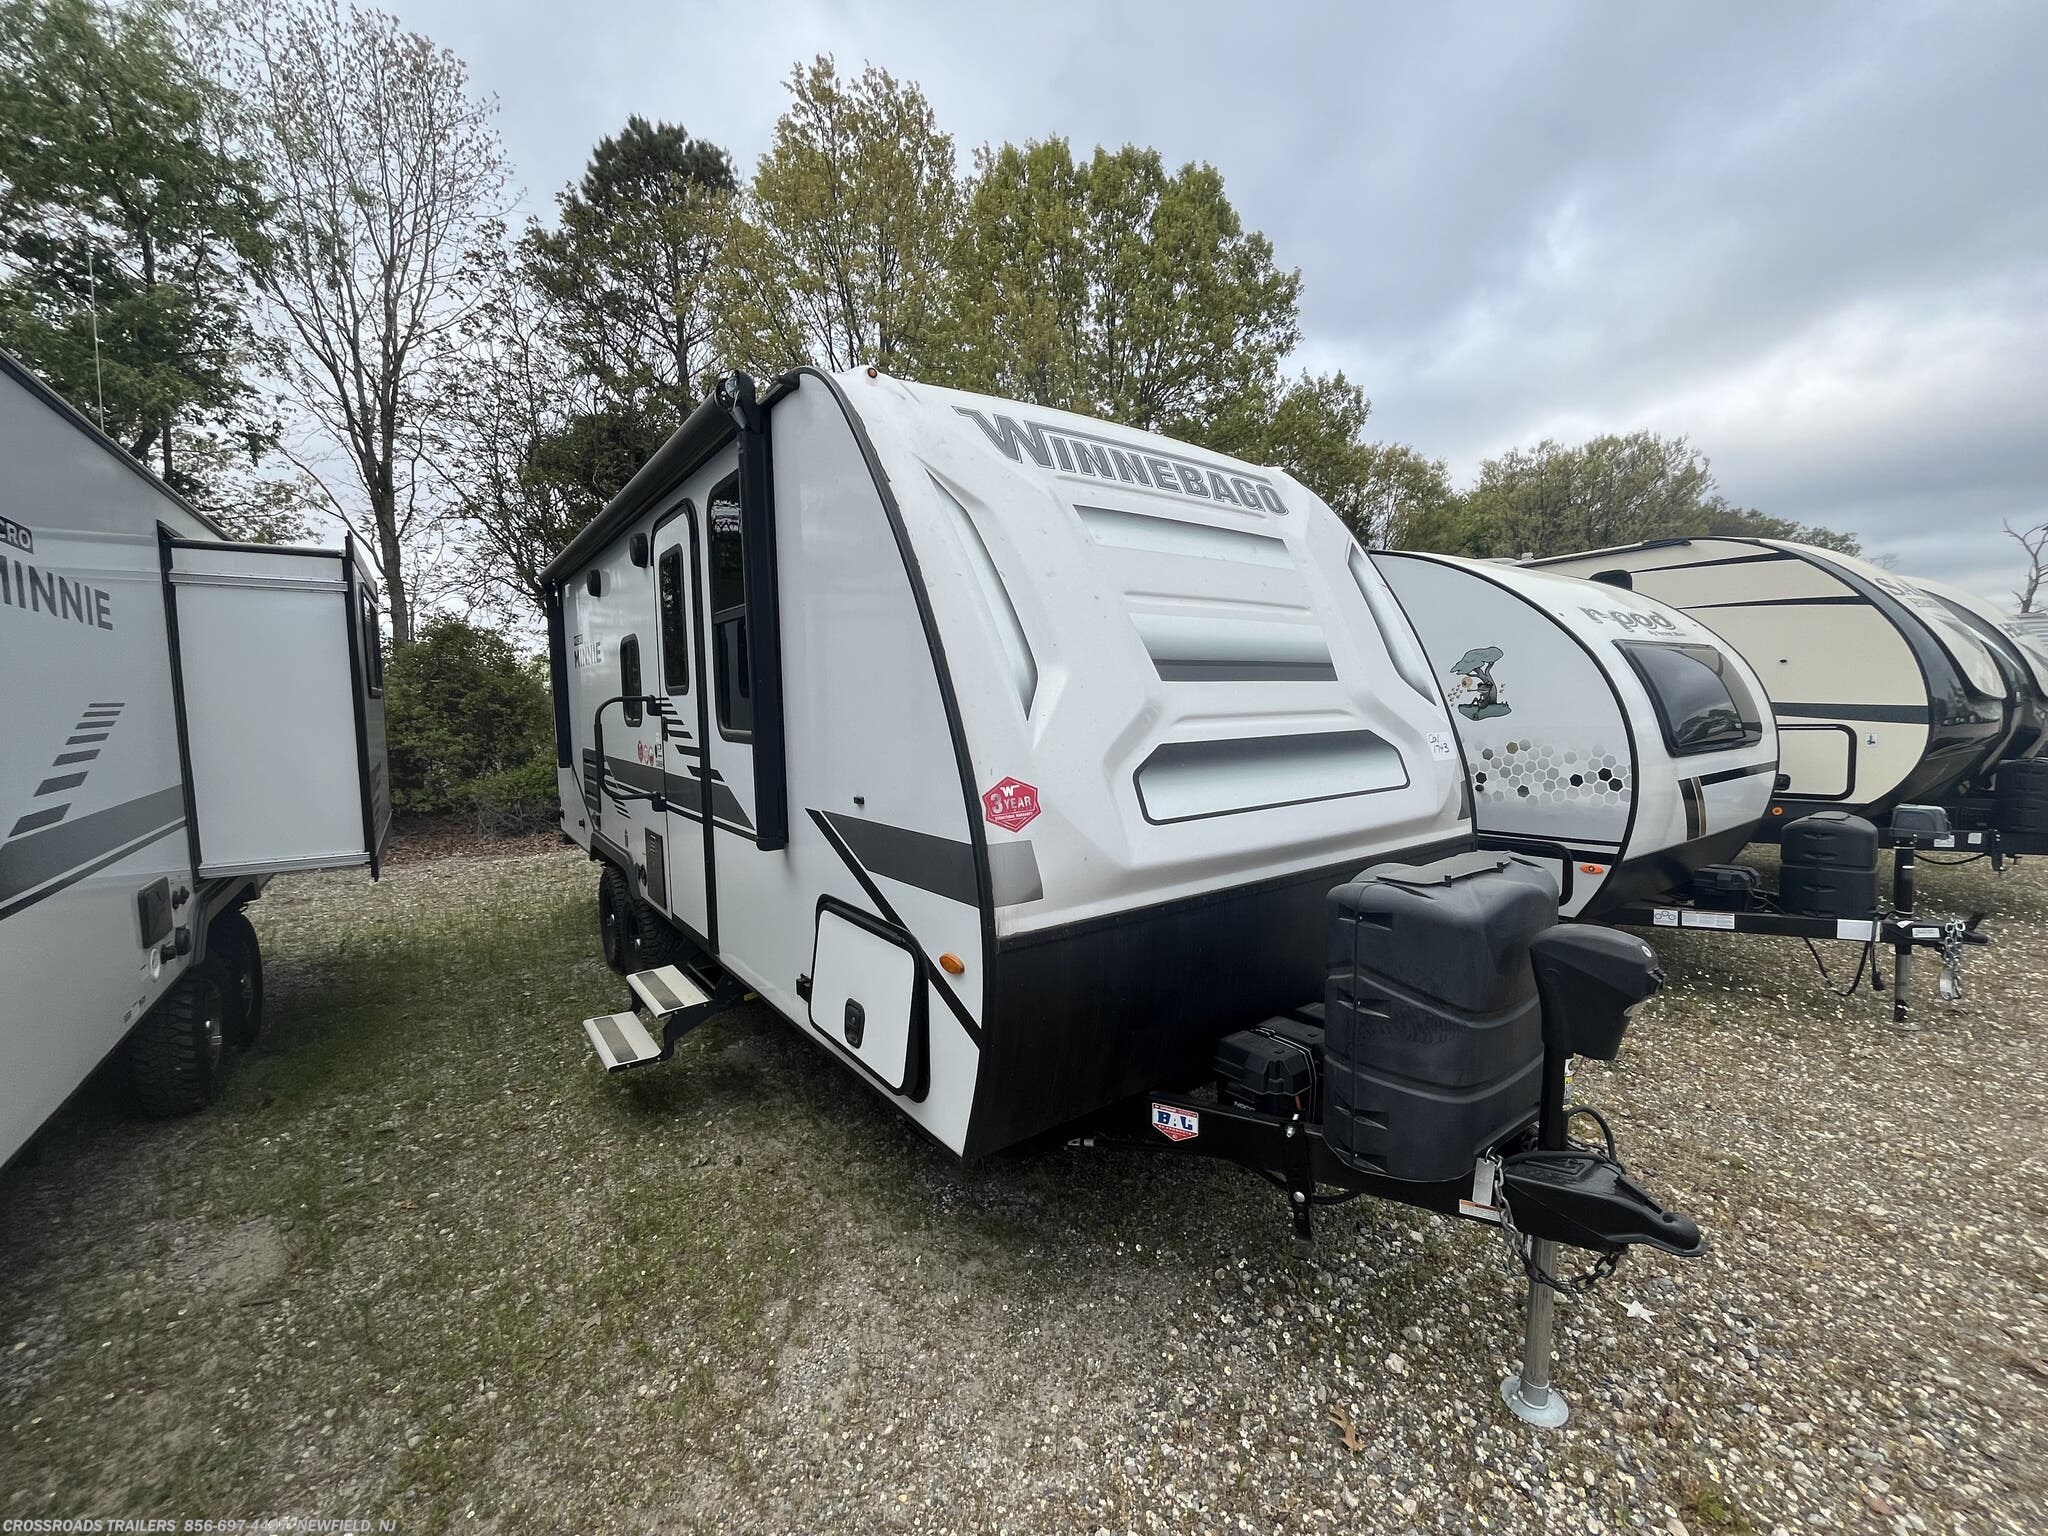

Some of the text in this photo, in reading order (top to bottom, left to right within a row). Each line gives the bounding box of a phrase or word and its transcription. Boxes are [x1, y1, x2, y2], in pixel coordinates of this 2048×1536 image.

[951, 405, 1289, 515] WINNEBAGO
[990, 793, 1031, 814] 3 YEAR
